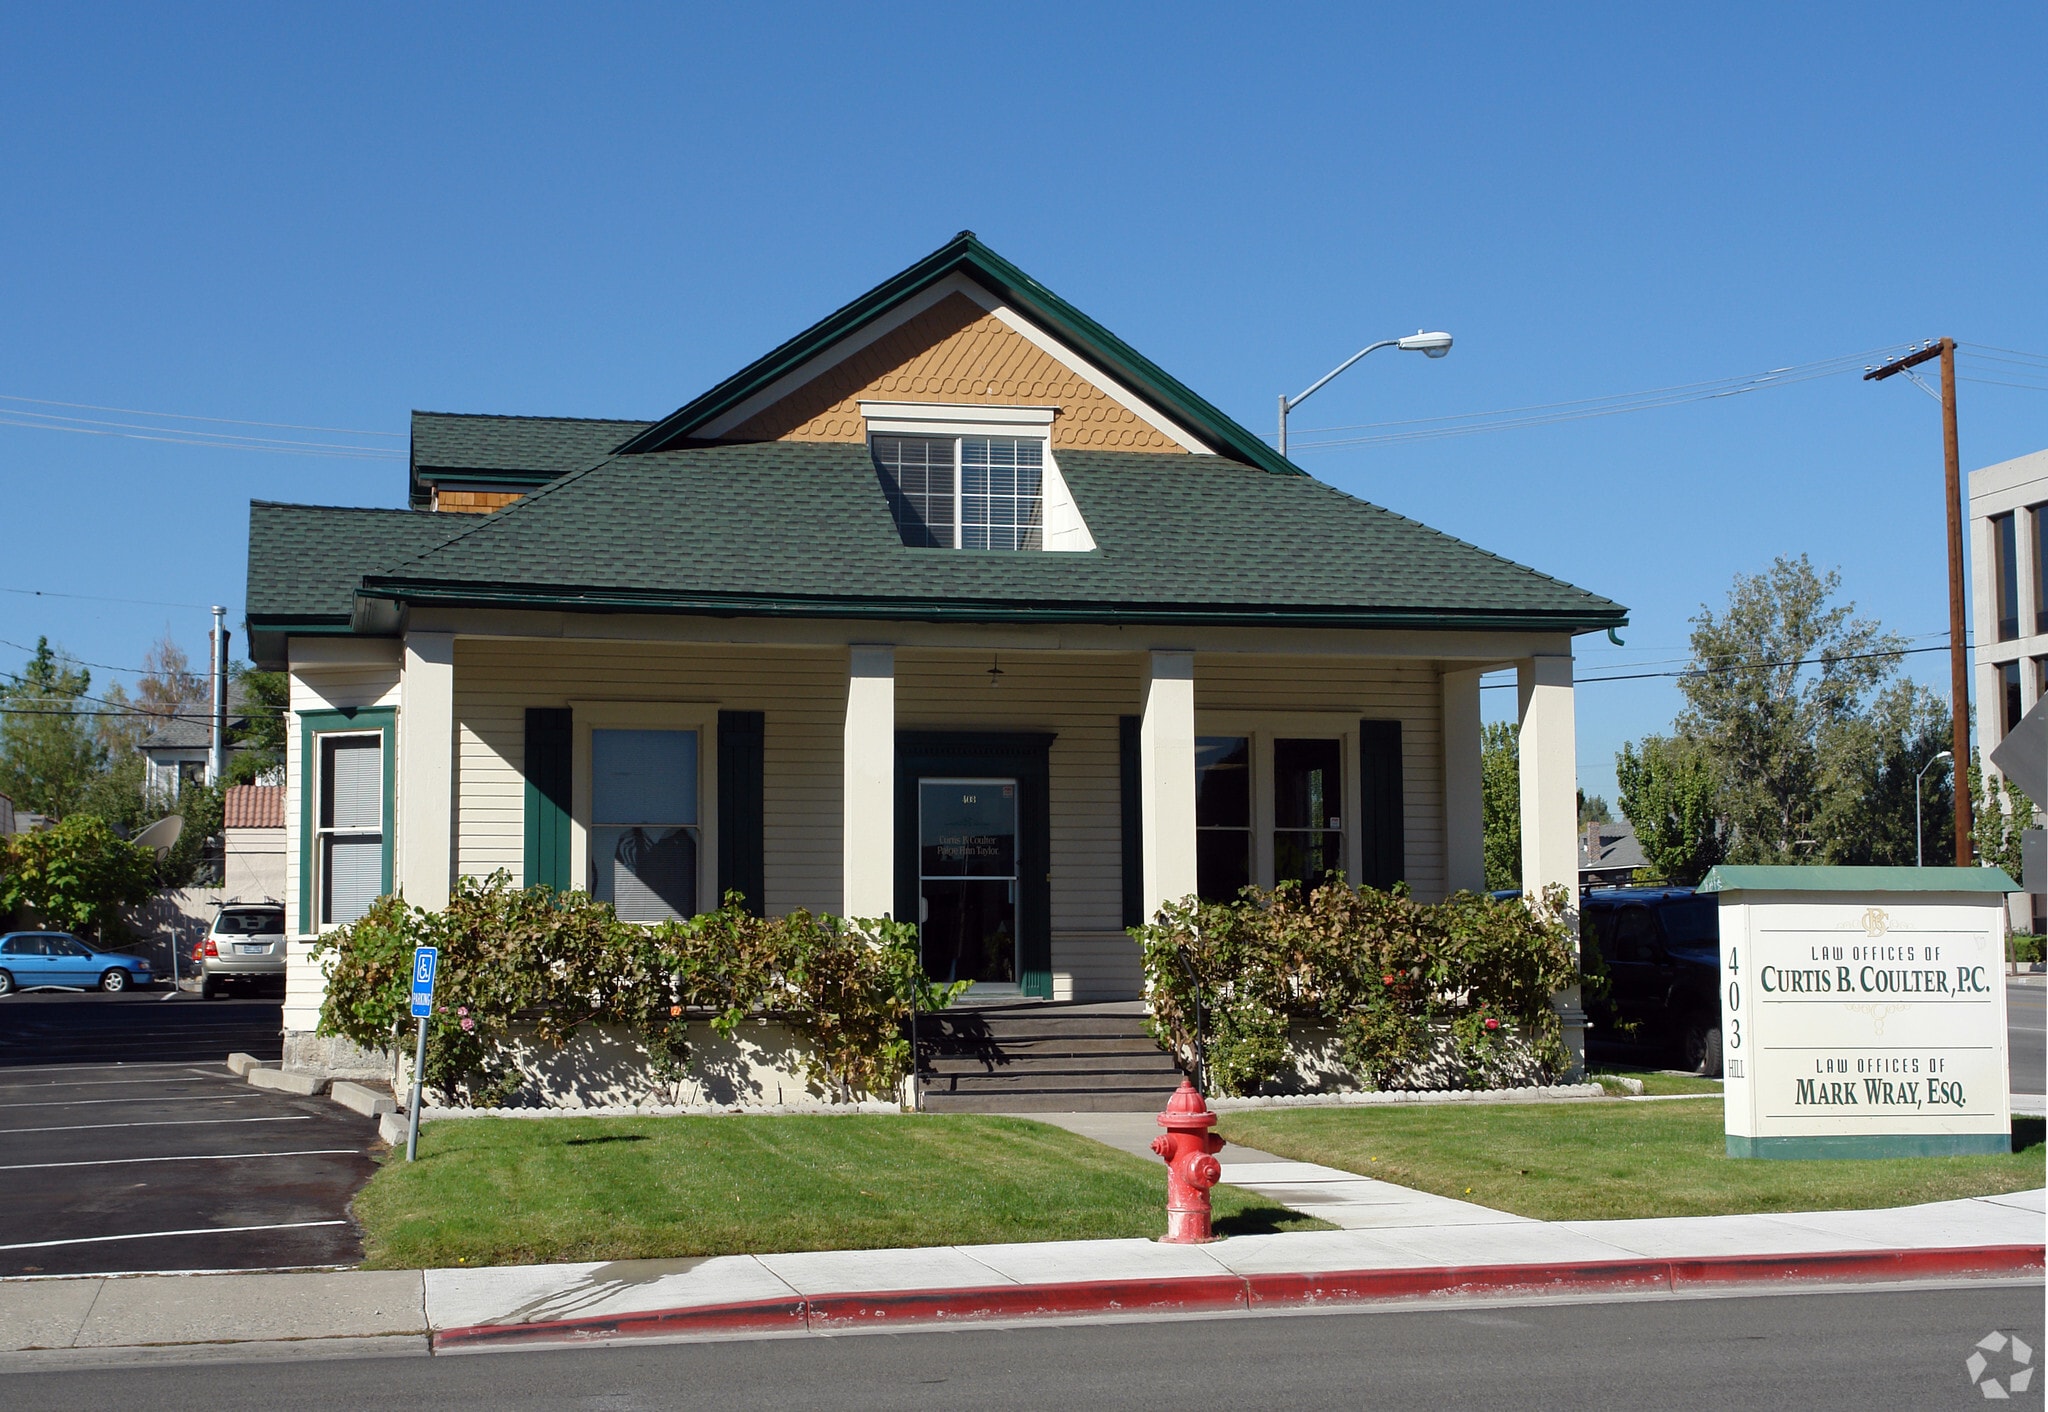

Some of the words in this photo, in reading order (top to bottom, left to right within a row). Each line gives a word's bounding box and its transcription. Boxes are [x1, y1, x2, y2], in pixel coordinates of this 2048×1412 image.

[1811, 946, 1843, 961] LAW
[1852, 946, 1914, 961] OFFICES
[1924, 946, 1941, 961] OF
[1835, 965, 1856, 993] B.
[1956, 965, 1991, 993] P.C.
[1728, 1058, 1745, 1079] HILL
[1816, 1058, 1848, 1074] LAW
[1857, 1058, 1919, 1074] OFFICES
[1929, 1057, 1945, 1073] OF
[1794, 1078, 1859, 1106] MARK
[1926, 1077, 1966, 1108] ESQ.
